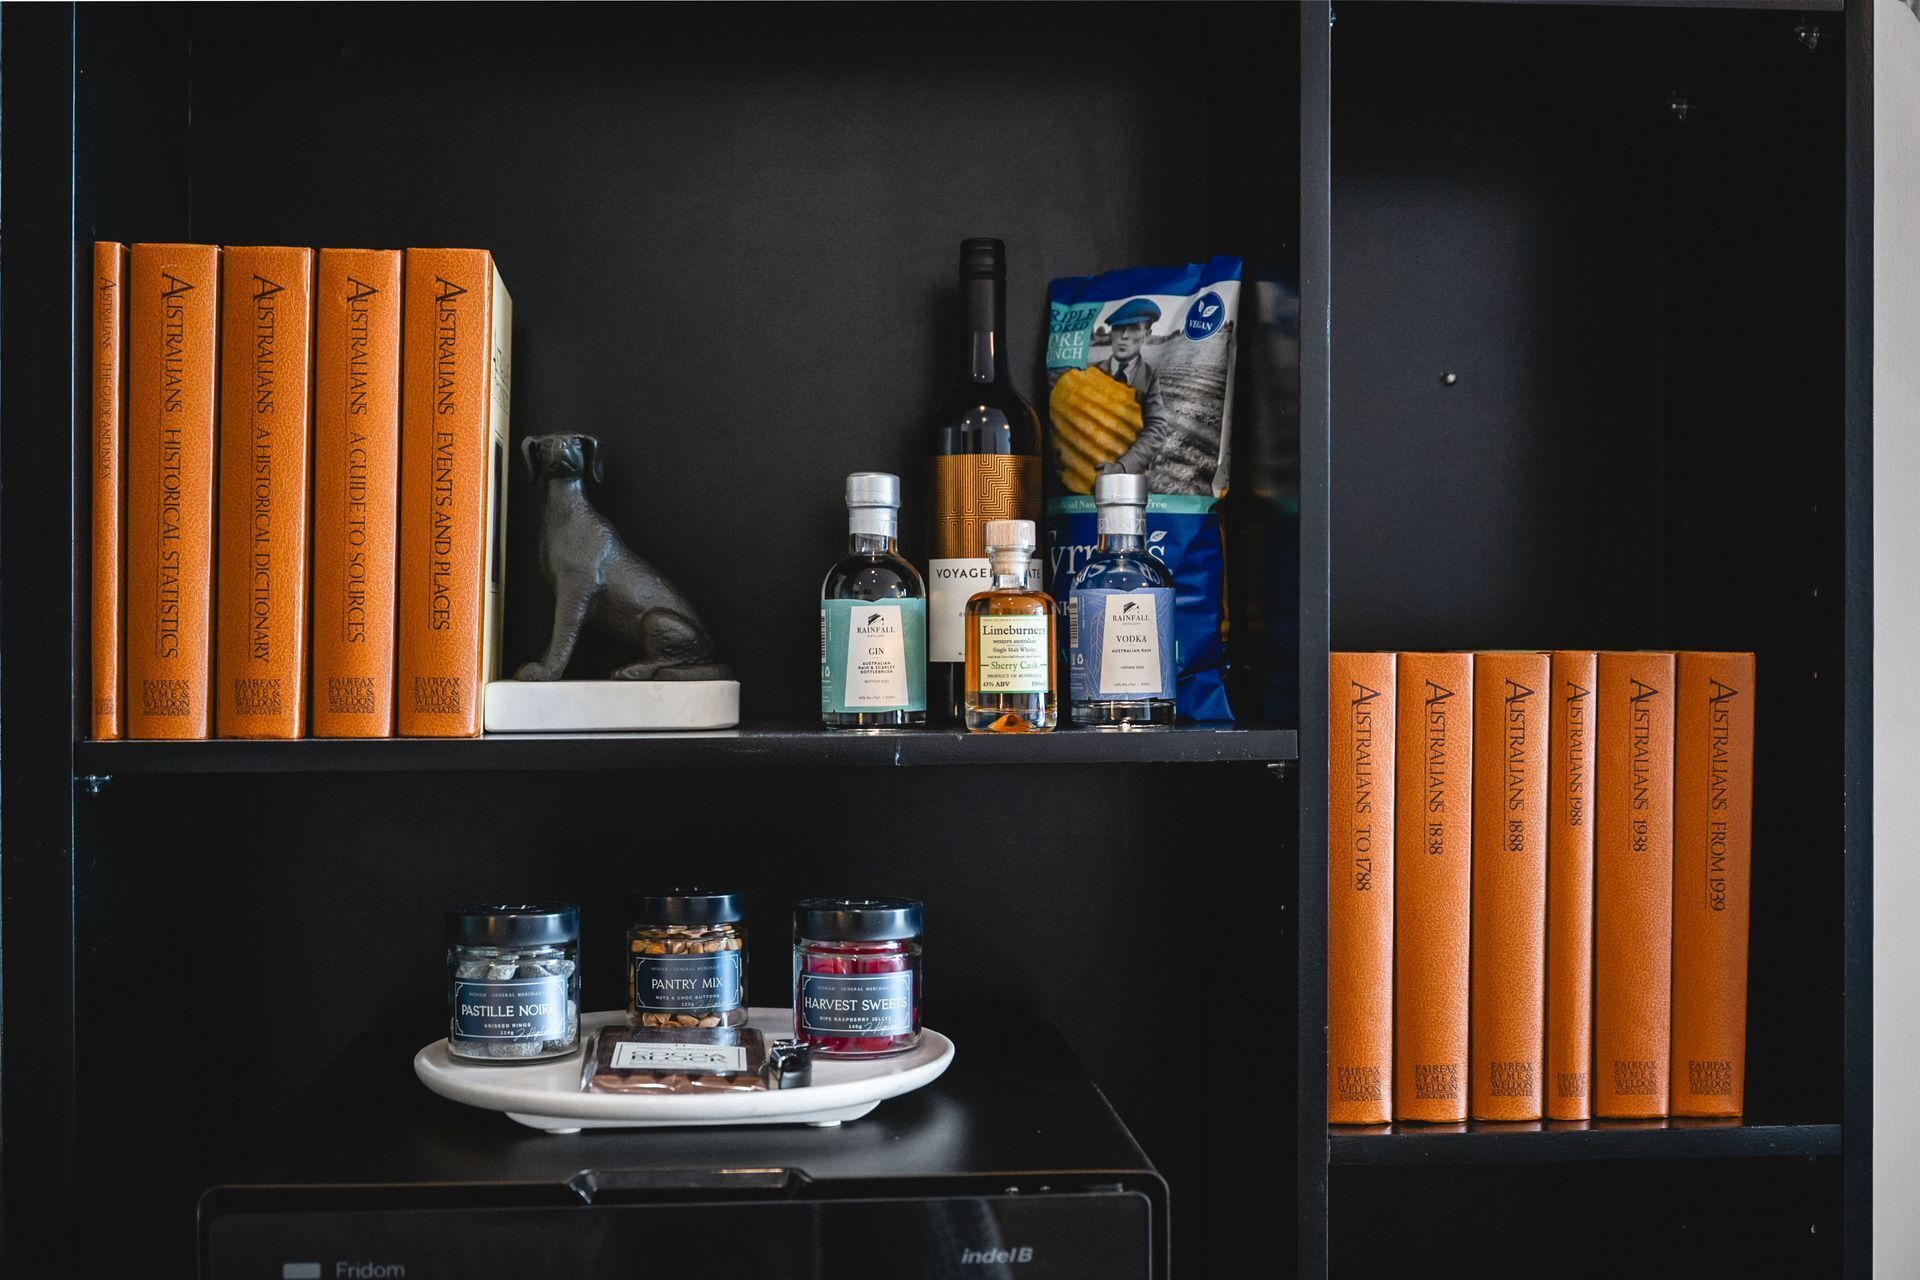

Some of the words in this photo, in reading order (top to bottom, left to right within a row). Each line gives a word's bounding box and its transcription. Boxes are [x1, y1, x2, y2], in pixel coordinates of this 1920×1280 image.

[100, 276, 117, 349] AUSTRALIANS
[1189, 319, 1213, 331] VEGAN
[162, 271, 194, 414] AUSTRALIANS
[253, 274, 285, 414] AUSTRALIANS
[347, 275, 379, 416] AUSTRALIANS
[436, 275, 468, 416] AUSTRALIANS
[101, 386, 111, 416] GUIDE
[101, 419, 111, 444] AND
[257, 427, 271, 442] A
[350, 432, 366, 447] A
[101, 447, 112, 480] INDEX
[435, 431, 454, 506] EVENTS
[349, 448, 367, 512] GUIDE
[161, 429, 181, 547] HISTORICAL
[254, 445, 272, 548] HISTORICAL
[349, 515, 365, 546] TO
[435, 509, 452, 556] AND
[347, 551, 366, 643] SOURCES
[432, 560, 451, 631] PLACES
[160, 552, 179, 659] STATISTICS
[252, 553, 271, 663] DICTIONARY
[1112, 614, 1150, 622] RAINFALL
[857, 626, 896, 634] RAINFALL
[983, 625, 1046, 636] Limeburners
[1116, 635, 1147, 643] VODKA
[868, 647, 885, 655] GIN
[991, 661, 1018, 671] Sherry
[1020, 661, 1039, 670] Cask
[143, 679, 189, 689] FAIRFAX
[235, 678, 281, 688] FAIRFAX
[328, 677, 375, 687] FAIRFAX
[414, 677, 459, 687] FAIRFAX
[143, 688, 178, 698] SYME
[180, 688, 189, 697] &
[235, 687, 268, 698] SYME
[271, 688, 281, 697] &
[328, 686, 362, 696] SYME
[364, 686, 374, 696] &
[414, 686, 447, 696] SYME
[450, 686, 459, 696] &
[143, 698, 189, 708] WELDON
[235, 698, 280, 708] WELDON
[328, 696, 374, 706] WELDON
[415, 696, 459, 706] WELDON
[1566, 680, 1591, 793] AUSTRALIANS
[1630, 677, 1659, 810] AUSTRALIANS
[1351, 679, 1381, 814] AUSTRALIANS
[1425, 678, 1455, 813] AUSTRALIANS
[1505, 677, 1535, 812] AUSTRALIANS
[1709, 677, 1739, 811] AUSTRALIANS
[1568, 795, 1583, 826] 1988
[1354, 824, 1371, 853] TO
[1428, 821, 1444, 855] 1838
[1507, 819, 1524, 852] 1888
[1631, 819, 1649, 852] 1938
[1709, 820, 1728, 876] FROM
[1355, 855, 1372, 891] 1788
[1710, 878, 1726, 912] 1939
[651, 978, 698, 990] PANTRY
[702, 977, 723, 989] MIX
[461, 1004, 515, 1017] PASTILLE
[804, 996, 858, 1011] HARVEST
[861, 996, 907, 1011] SWEETS
[1337, 1066, 1381, 1075] FAIRFAX
[1415, 1064, 1457, 1073] FAIRFAX
[1490, 1062, 1534, 1071] FAIRFAX
[1613, 1060, 1657, 1070] FAIRFAX
[1688, 1060, 1732, 1070] FAIRFAX
[1337, 1075, 1370, 1084] SYME
[1371, 1075, 1381, 1084] &
[1415, 1073, 1445, 1083] SYME
[1448, 1073, 1457, 1083] &
[1490, 1071, 1521, 1080] SYME
[1523, 1071, 1533, 1080] &
[1614, 1070, 1647, 1080] SYME
[1648, 1070, 1657, 1080] &
[1688, 1070, 1720, 1080] SYME
[1722, 1070, 1732, 1080] &
[1338, 1084, 1381, 1093] WELDON
[1415, 1083, 1457, 1092] WELDON
[1490, 1081, 1533, 1090] WELDON
[1614, 1080, 1657, 1089] WELDON
[1688, 1080, 1731, 1089] WELDON
[335, 1262, 406, 1279] Fridom
